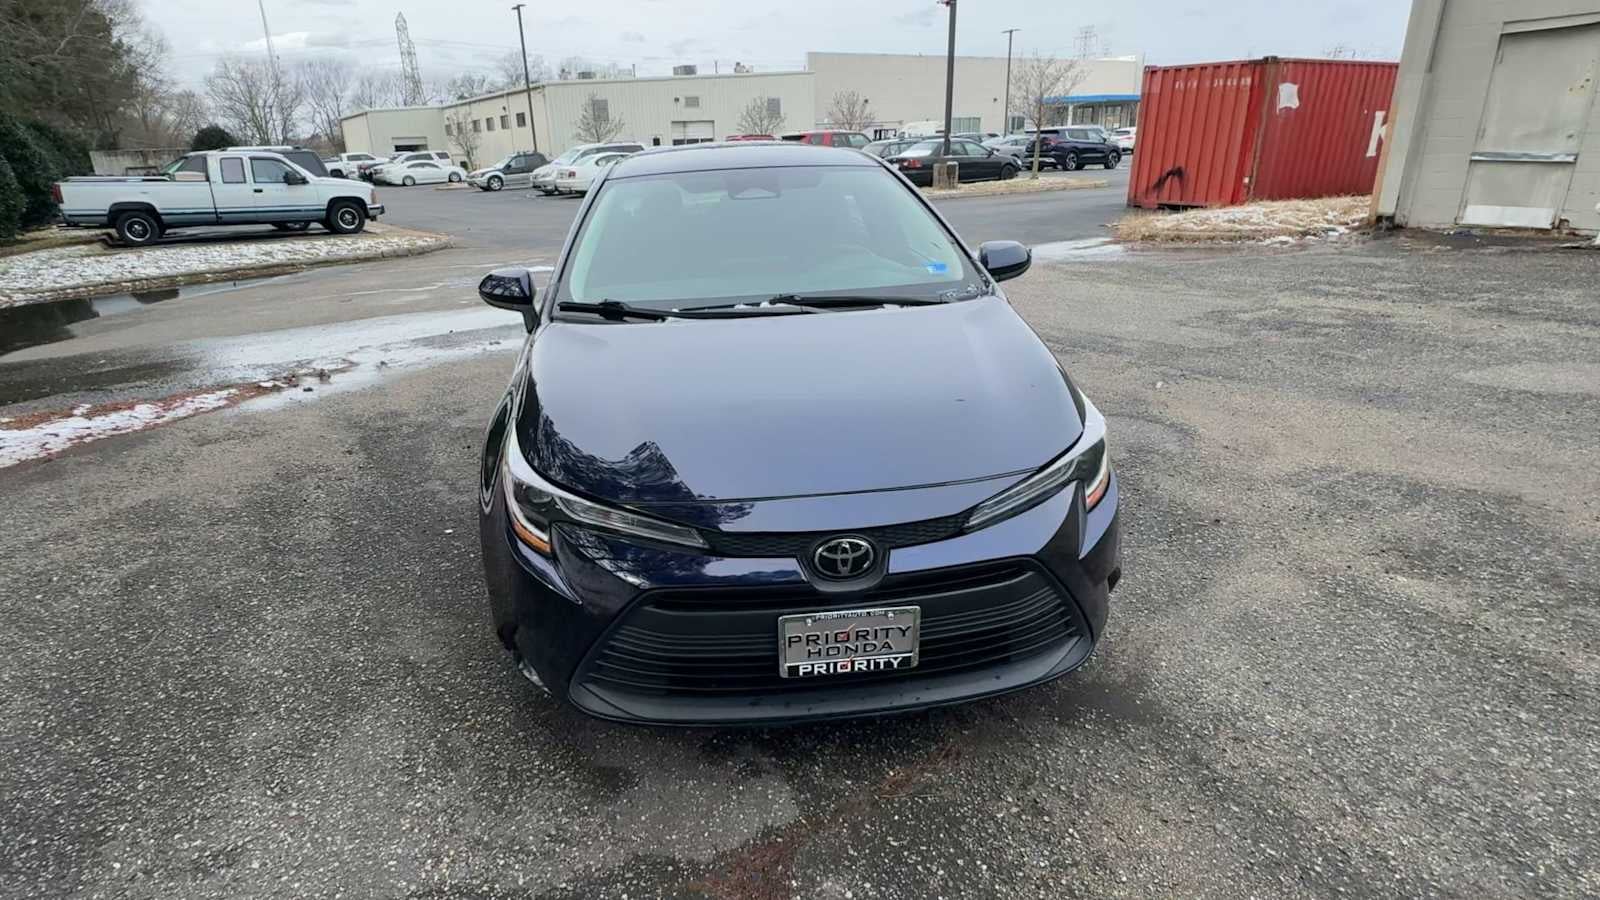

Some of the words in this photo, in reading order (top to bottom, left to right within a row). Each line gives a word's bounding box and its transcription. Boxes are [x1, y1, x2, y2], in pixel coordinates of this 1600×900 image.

[787, 625, 913, 648] PRIORITY
[807, 641, 894, 658] HONDA
[798, 656, 903, 677] PRIORITY
